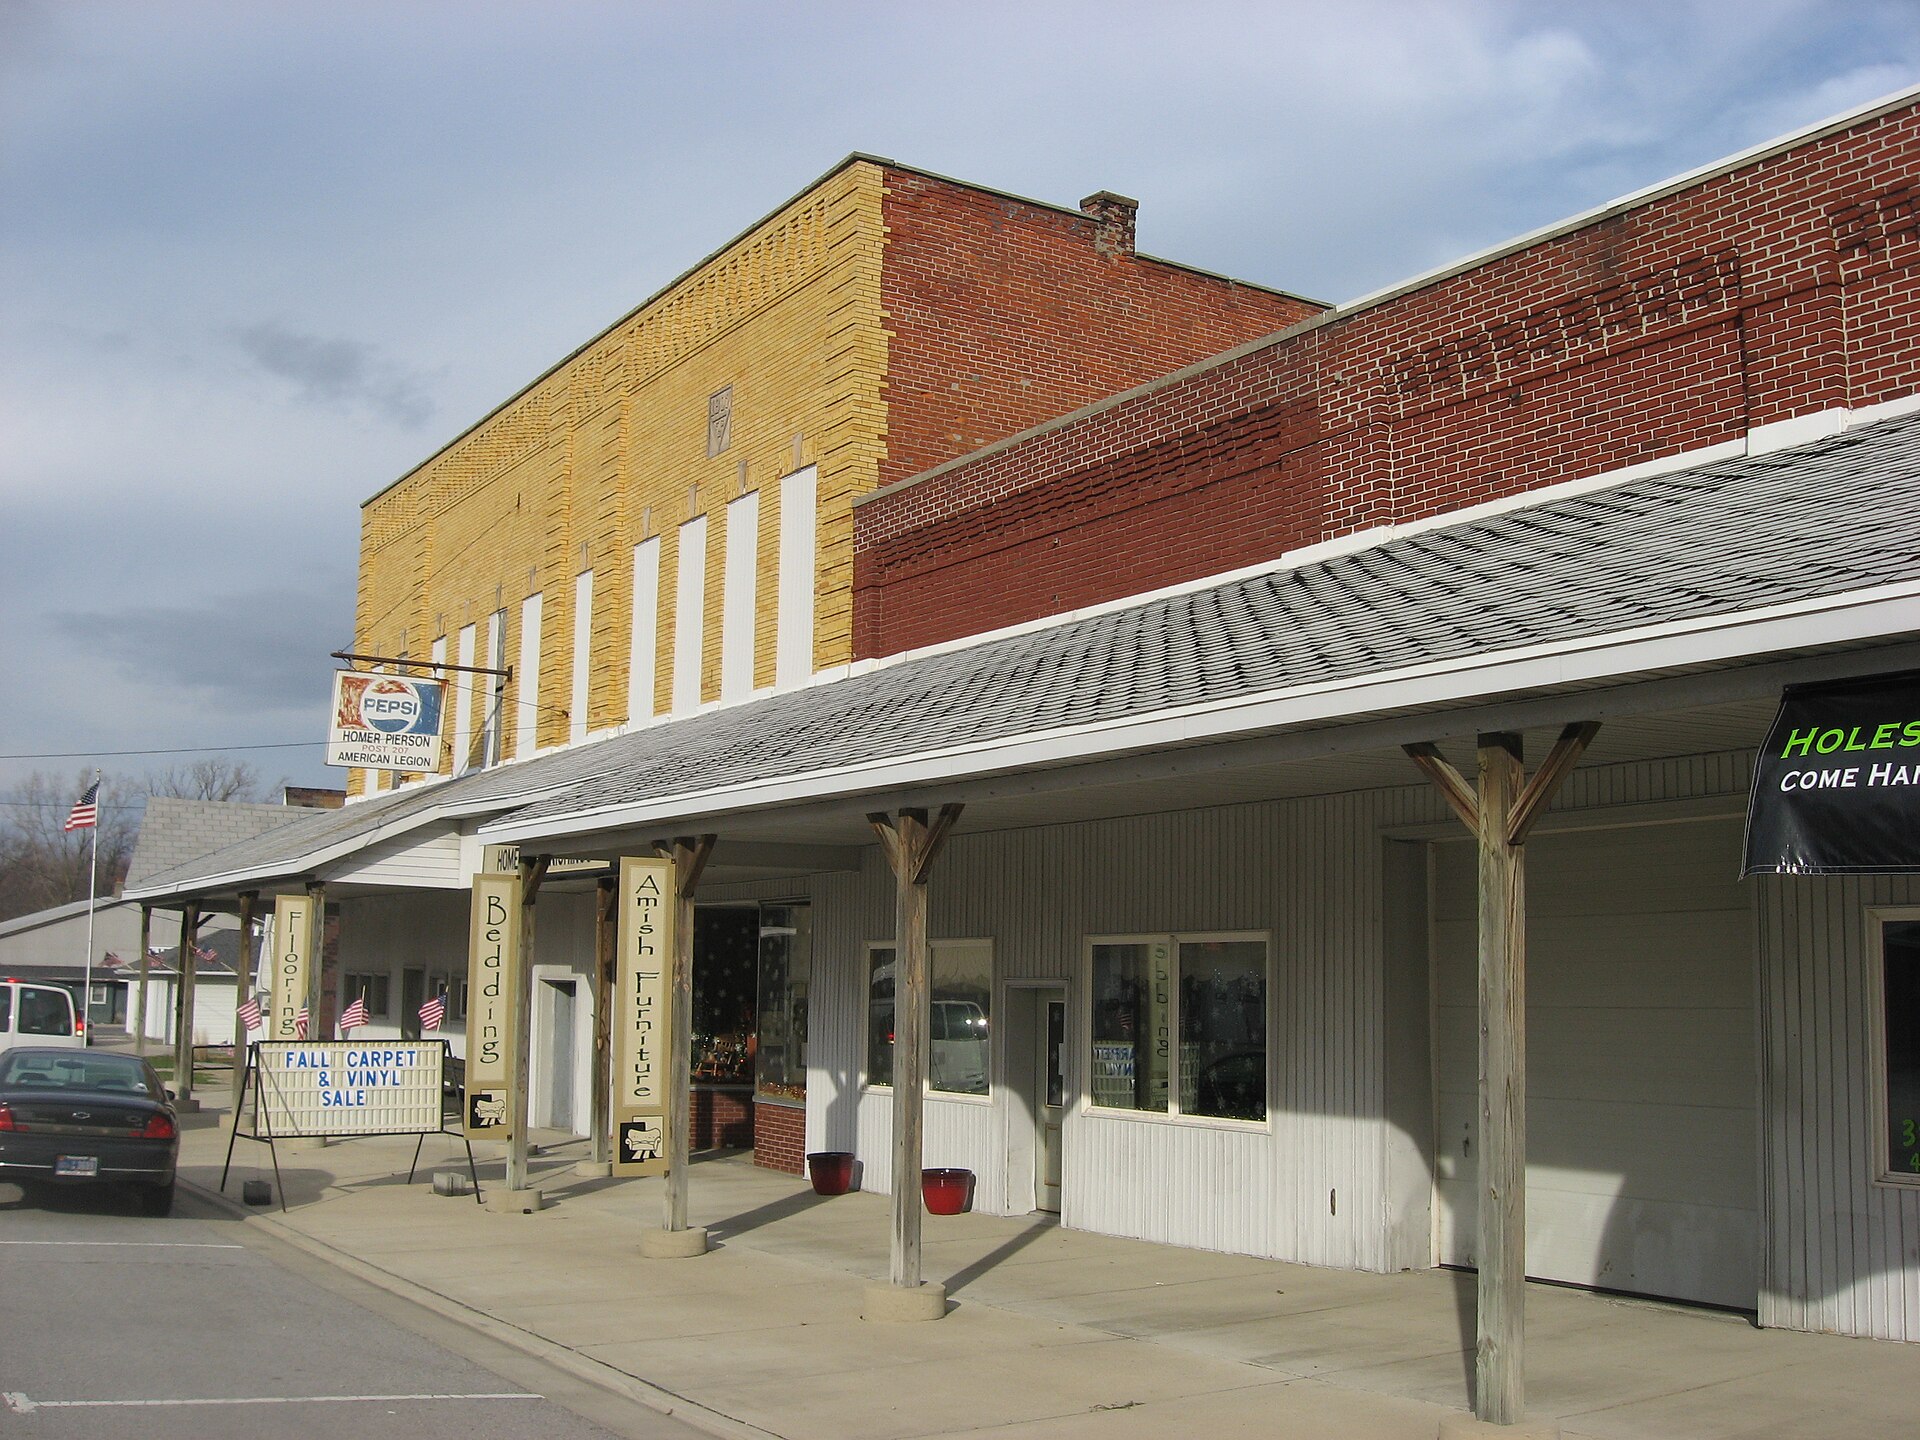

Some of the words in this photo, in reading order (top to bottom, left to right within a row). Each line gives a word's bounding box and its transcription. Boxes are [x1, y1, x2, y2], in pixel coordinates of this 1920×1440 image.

[364, 698, 417, 715] PEPSI
[342, 730, 381, 744] HOMER
[385, 734, 430, 747] PIERSON
[1780, 720, 1920, 760] HOLES
[362, 745, 388, 753] POST
[338, 752, 390, 764] AMERICAN
[394, 755, 431, 767] LEGION
[1780, 767, 1859, 792] COME
[635, 874, 660, 956] Amish
[280, 911, 302, 1036] Flooring
[480, 895, 507, 1064] Bedding
[634, 971, 660, 1098] Furniture
[286, 1052, 330, 1068] FALL
[347, 1050, 416, 1067] CARPET
[318, 1071, 330, 1088] &
[347, 1070, 400, 1087] VINYL
[322, 1090, 365, 1107] SALE
